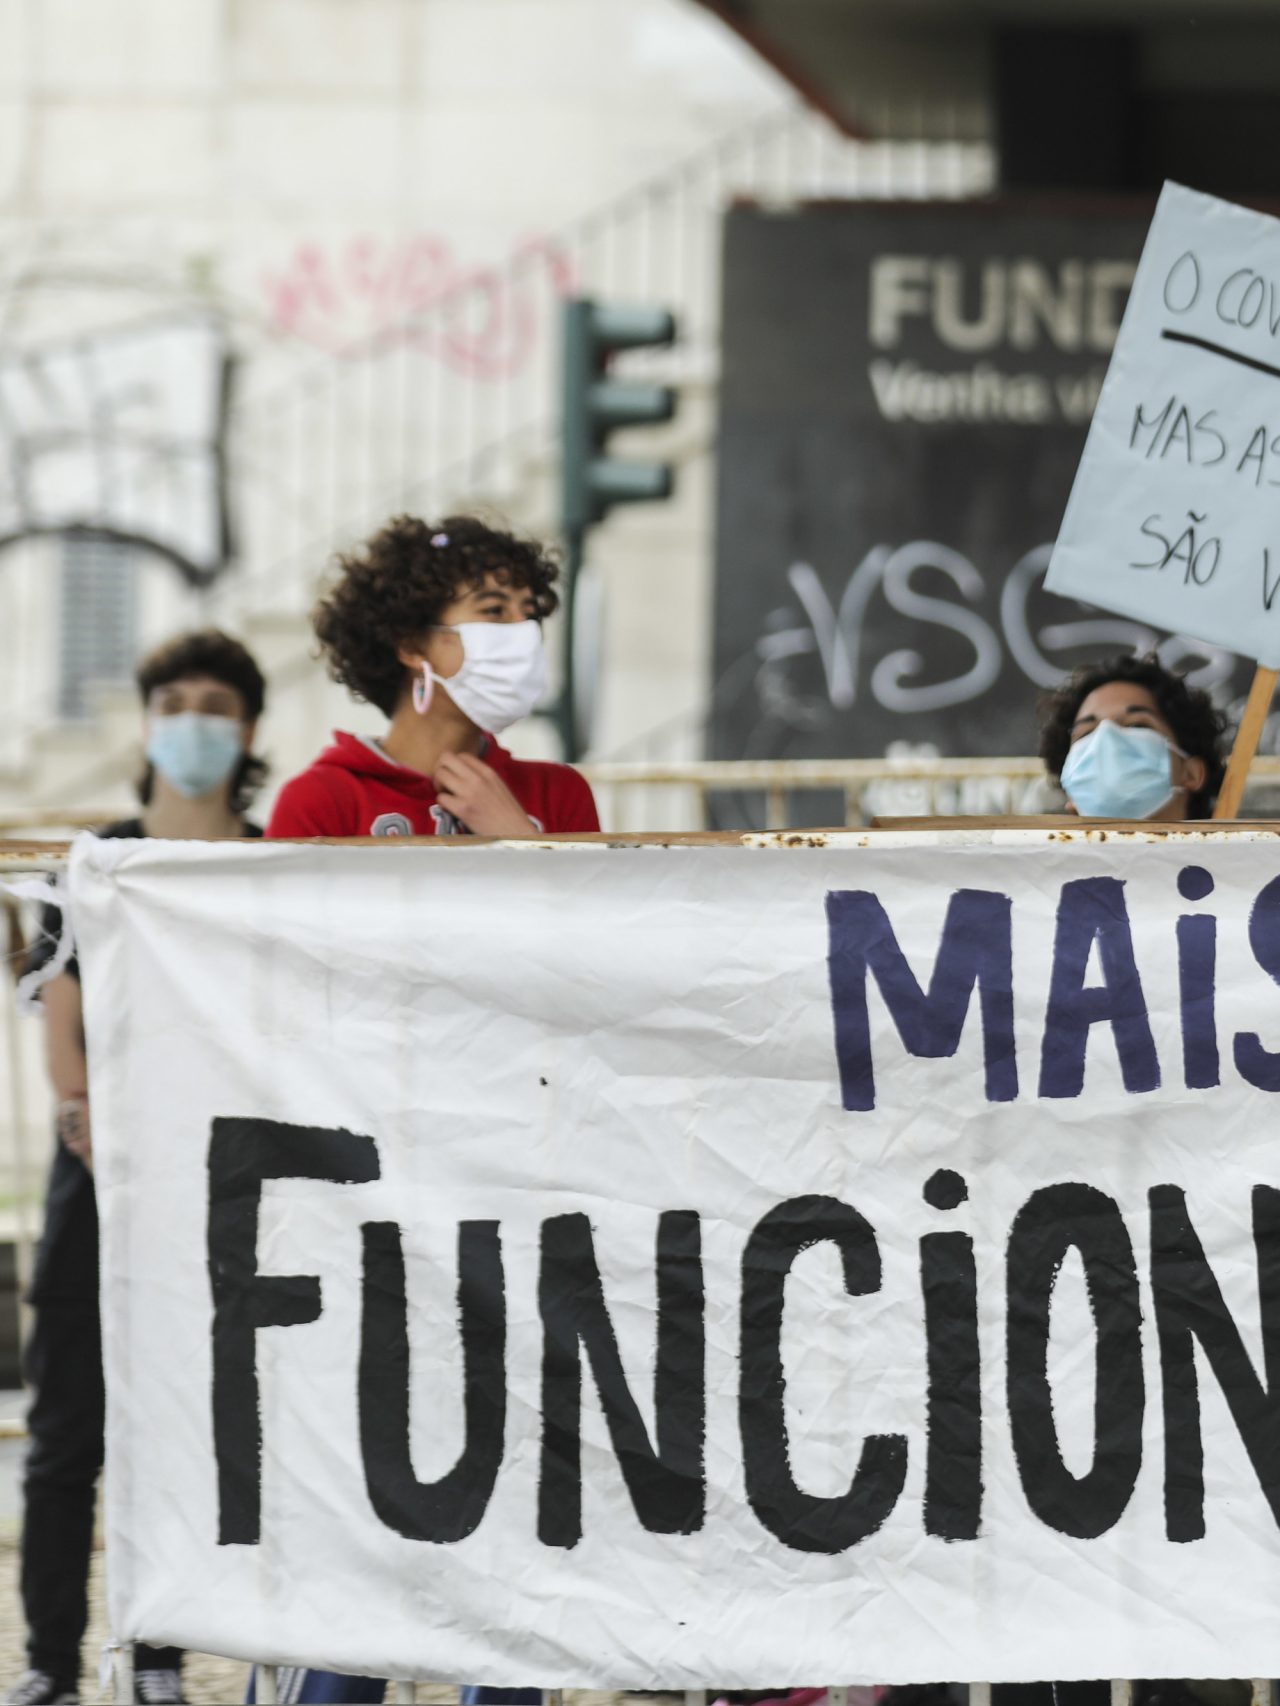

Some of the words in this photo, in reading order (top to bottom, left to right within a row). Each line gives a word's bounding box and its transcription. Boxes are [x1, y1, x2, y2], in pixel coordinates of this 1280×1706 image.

[1164, 251, 1200, 315] O
[1130, 396, 1227, 467] MAS
[1130, 510, 1221, 586] SÃO
